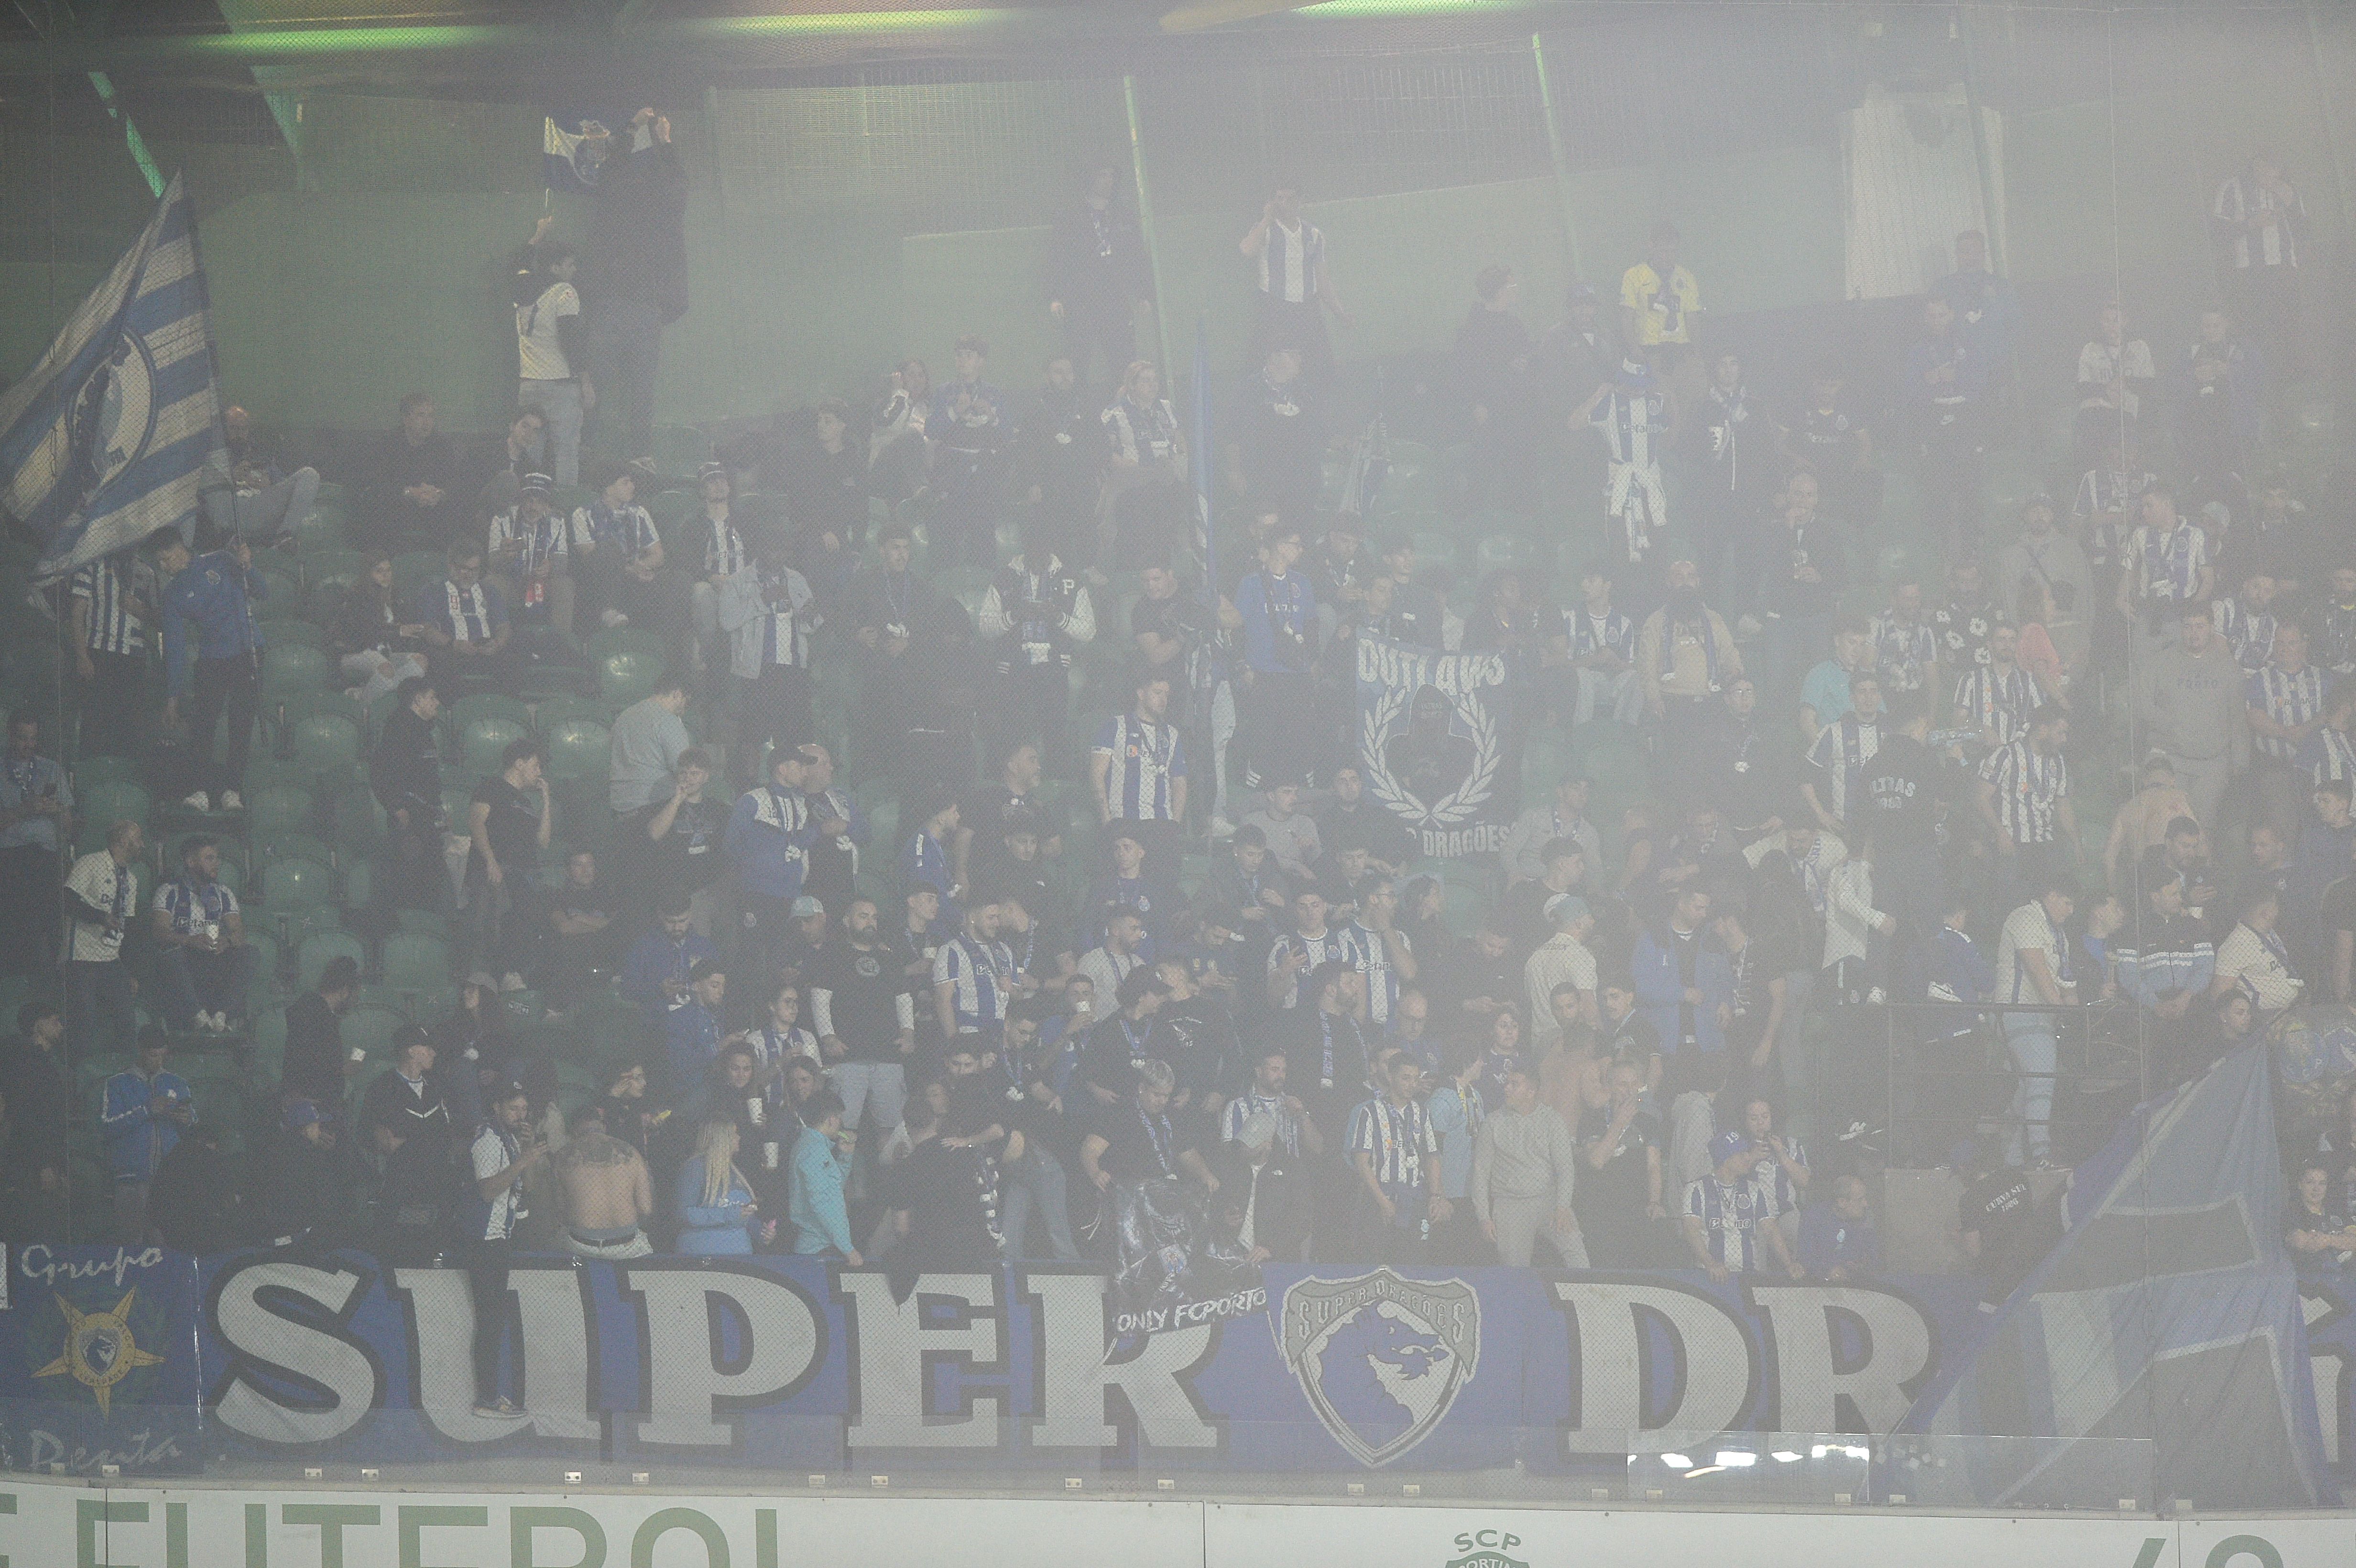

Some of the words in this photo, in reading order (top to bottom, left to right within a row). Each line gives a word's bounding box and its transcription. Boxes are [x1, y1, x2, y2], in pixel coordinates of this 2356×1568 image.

[1985, 1191, 2011, 1212] CURVA
[22, 1244, 163, 1287] Grupo
[1117, 1308, 1168, 1332] ONLY
[1299, 1287, 1367, 1340] SUPER
[1375, 1280, 1465, 1344] DRAGÕES
[216, 1261, 1218, 1448] SUPER
[1454, 1529, 1521, 1552] SCP
